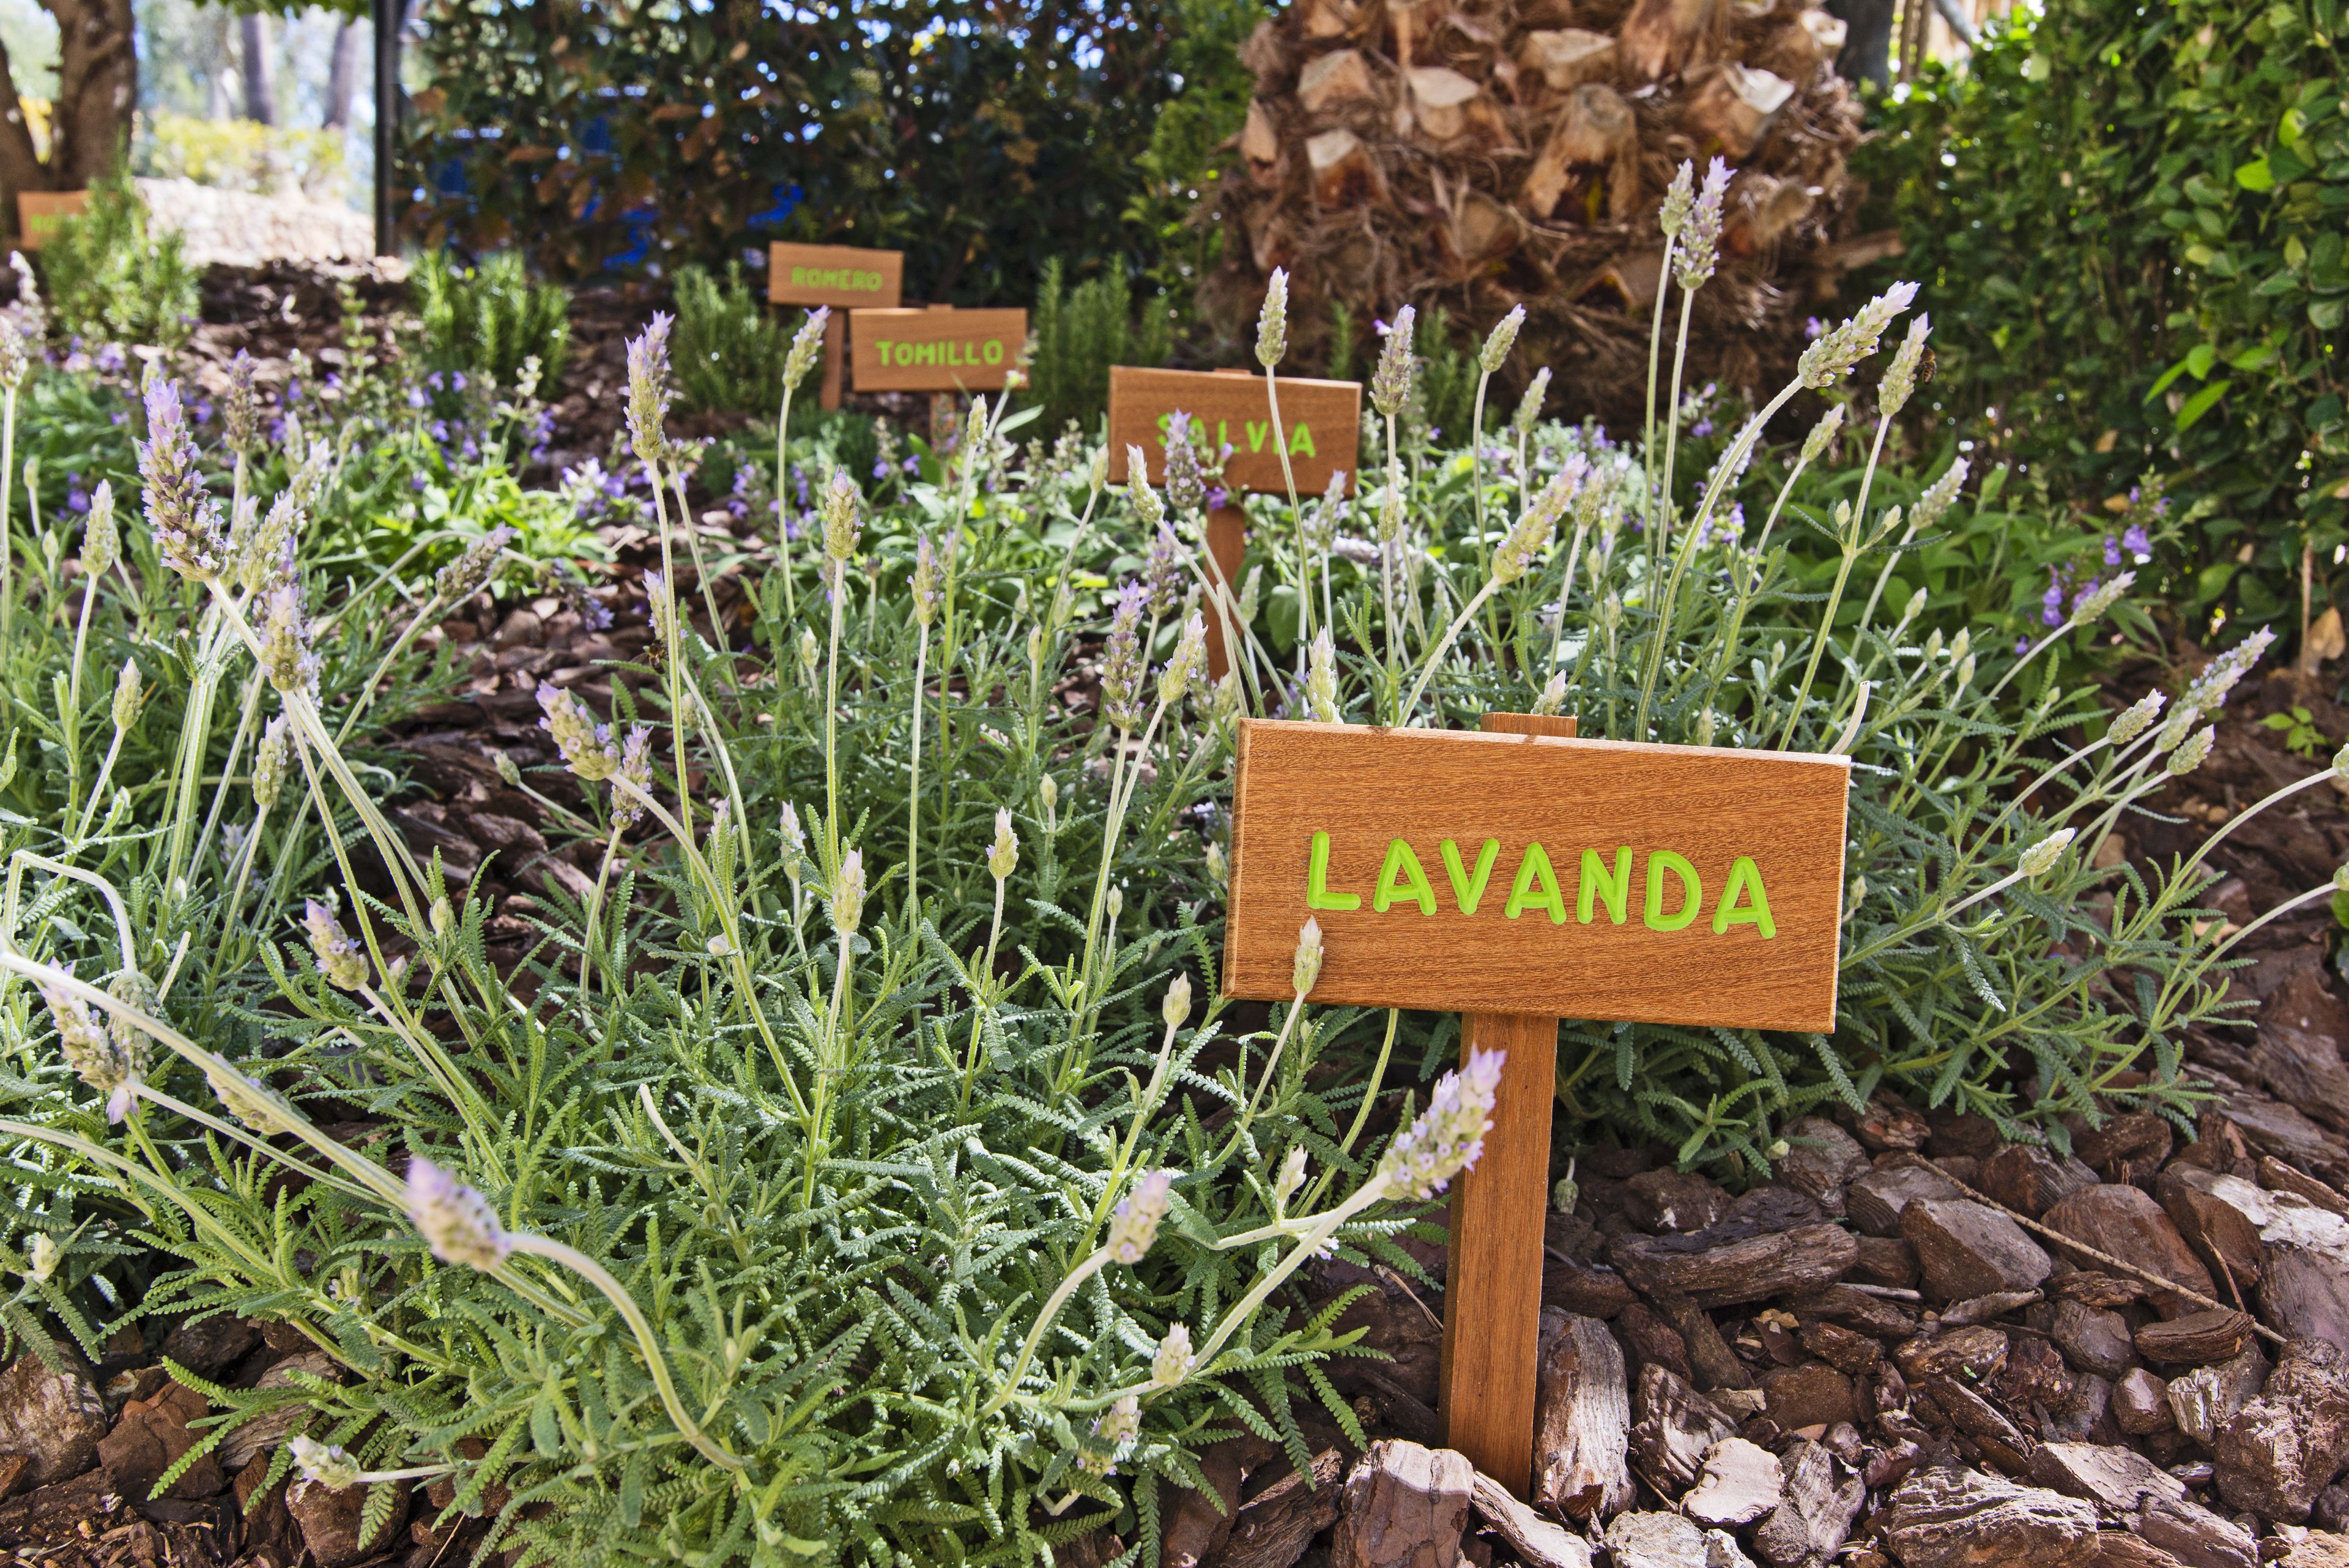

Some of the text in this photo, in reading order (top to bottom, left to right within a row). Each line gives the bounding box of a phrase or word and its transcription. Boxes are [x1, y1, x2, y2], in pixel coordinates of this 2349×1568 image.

[792, 266, 883, 292] ROMERO
[875, 339, 1003, 366] TOMILLO
[1306, 831, 1777, 939] LAVANDA
